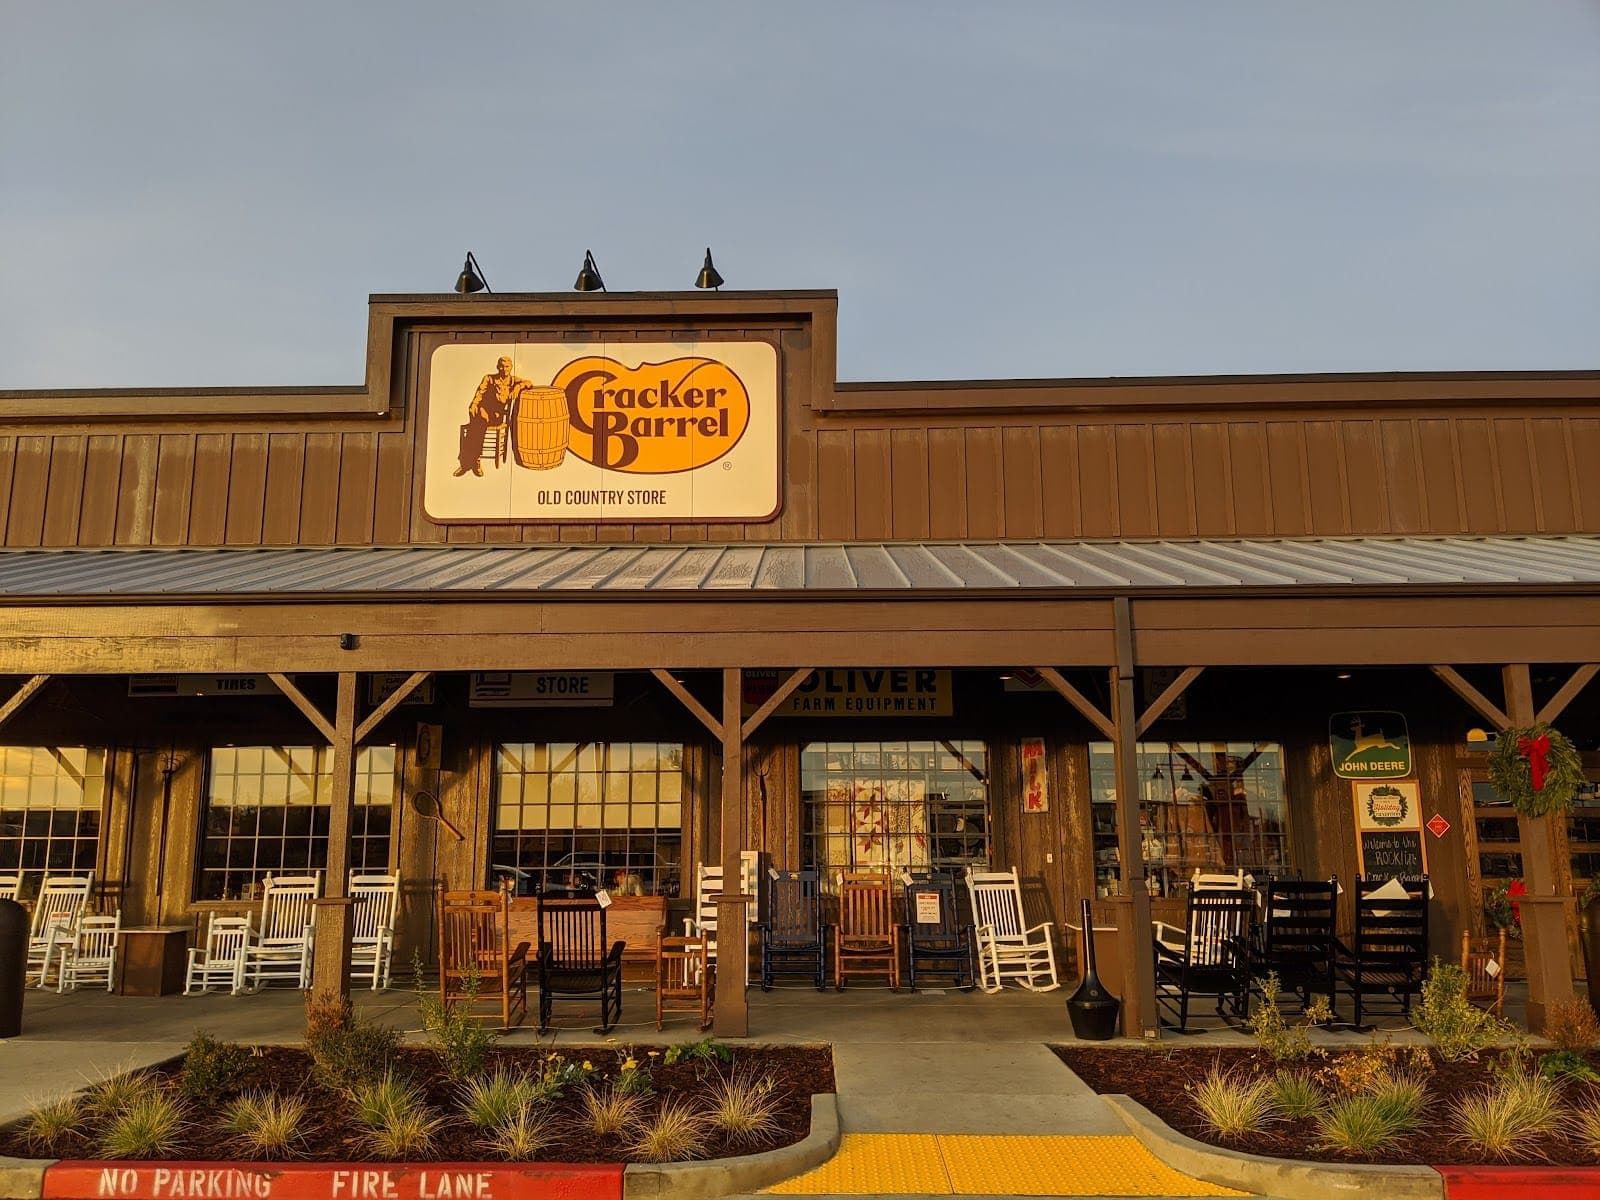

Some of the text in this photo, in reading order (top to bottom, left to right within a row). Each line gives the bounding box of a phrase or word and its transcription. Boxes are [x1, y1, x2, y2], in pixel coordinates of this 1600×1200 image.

[564, 370, 727, 434] Cracker
[592, 408, 729, 469] Barrel
[537, 490, 667, 505] OLD COUNTRY STORE
[215, 679, 257, 690] TIRES
[536, 676, 589, 694] STORE
[793, 697, 937, 712] FARM EQUIPMENT
[1024, 740, 1043, 809] MILK
[1339, 761, 1406, 772] JOHN DEERE
[99, 1168, 493, 1199] NO PARKING FIRE LANE
